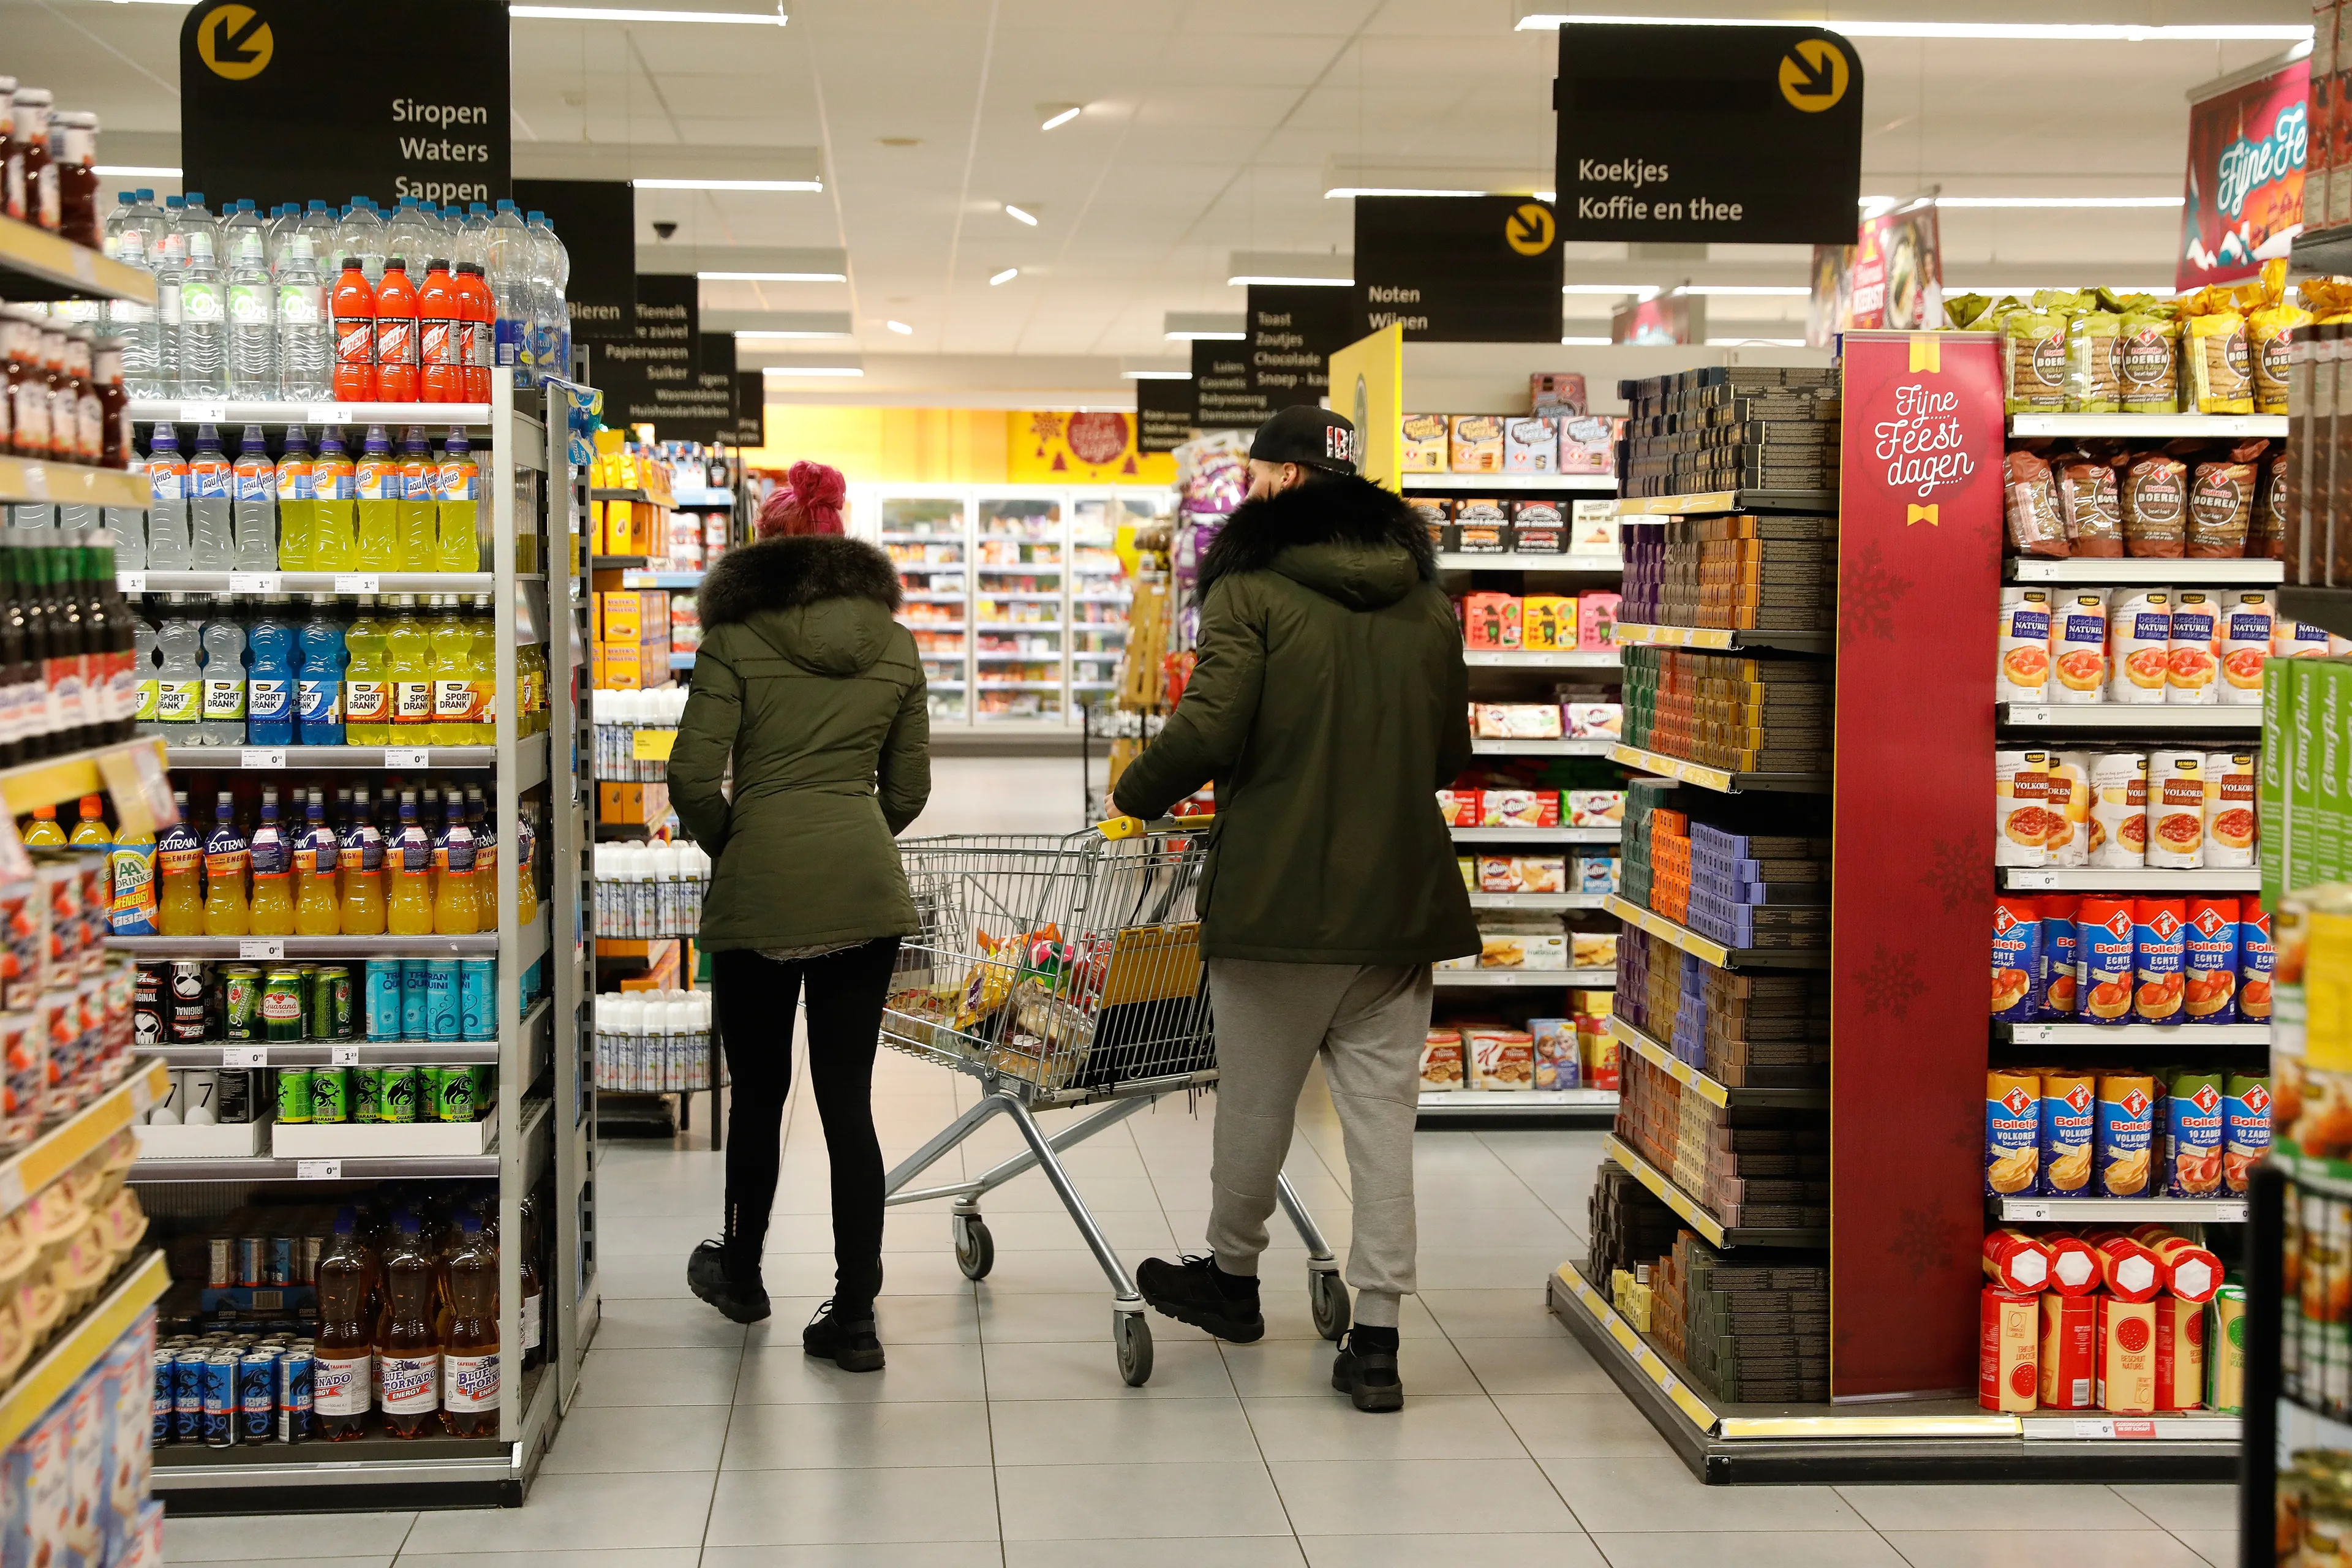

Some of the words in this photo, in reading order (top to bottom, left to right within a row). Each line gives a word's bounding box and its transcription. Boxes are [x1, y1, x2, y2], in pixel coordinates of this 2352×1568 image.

[393, 99, 488, 126] Siropen
[400, 137, 488, 162] Waters
[1578, 158, 1668, 188] Koekjes
[2217, 141, 2274, 217] Fijne
[395, 176, 488, 202] Sappen
[1578, 196, 1648, 221] Koffie
[1654, 202, 1683, 220] en
[1689, 197, 1743, 221] thee
[1368, 285, 1420, 304] Noten
[568, 301, 620, 320] Bieren
[1257, 312, 1291, 326] Toast
[650, 323, 688, 339] zuivel
[1256, 331, 1303, 348] Zoutjes
[605, 344, 689, 363] Papierwaren
[1253, 351, 1321, 367] Chocolade
[2125, 354, 2166, 364] BOEREN
[646, 364, 688, 380] Suiker
[1199, 375, 1247, 390] Cosmetic
[1257, 371, 1297, 389] Snoep
[1896, 384, 1958, 429] Fijne
[1875, 417, 1962, 459] Feest
[203, 464, 232, 491] AQUARIUS
[243, 468, 274, 493] AQUARIUS
[1887, 451, 1974, 497] dagen
[2138, 493, 2179, 502] BOEREN
[2193, 497, 2236, 508] BOEREN
[2016, 614, 2048, 622] beschuit
[2070, 617, 2103, 626] beschuit
[2174, 615, 2211, 625] beschuit
[2234, 614, 2270, 624] beschuit
[2015, 622, 2048, 630] NATUREL
[2173, 624, 2210, 632] NATUREL
[2233, 624, 2269, 632] NATUREL
[159, 837, 197, 851] EXTRAN
[209, 838, 246, 853] EXTRAN
[119, 862, 140, 878] AA
[117, 874, 148, 888] DRINK
[2140, 943, 2184, 954] Bolletje
[2186, 941, 2233, 953] Bolletje
[2106, 956, 2130, 965] ECHTE
[2151, 956, 2179, 965] ECHTE
[2195, 954, 2224, 963] ECHTE
[2193, 961, 2225, 970] beschuit
[175, 1006, 203, 1015] ORIGINAL
[264, 1000, 296, 1012] Guaraná
[198, 1083, 214, 1108] 7
[1992, 1118, 2038, 1130] Bolletje
[2054, 1115, 2094, 1127] Bolletje
[2110, 1120, 2151, 1131] Bolletje
[2182, 1116, 2222, 1128] Bolletje
[1997, 1131, 2035, 1141] VOLKOREN
[2115, 1133, 2150, 1142] VOLKOREN
[2188, 1129, 2199, 1138] 10
[2200, 1129, 2221, 1138] ZADEN
[2236, 1129, 2247, 1138] 10
[2002, 1139, 2031, 1147] beschuit
[383, 1368, 436, 1395] TORNADO
[457, 1368, 489, 1385] BLUE
[393, 1387, 421, 1400] ENERGY
